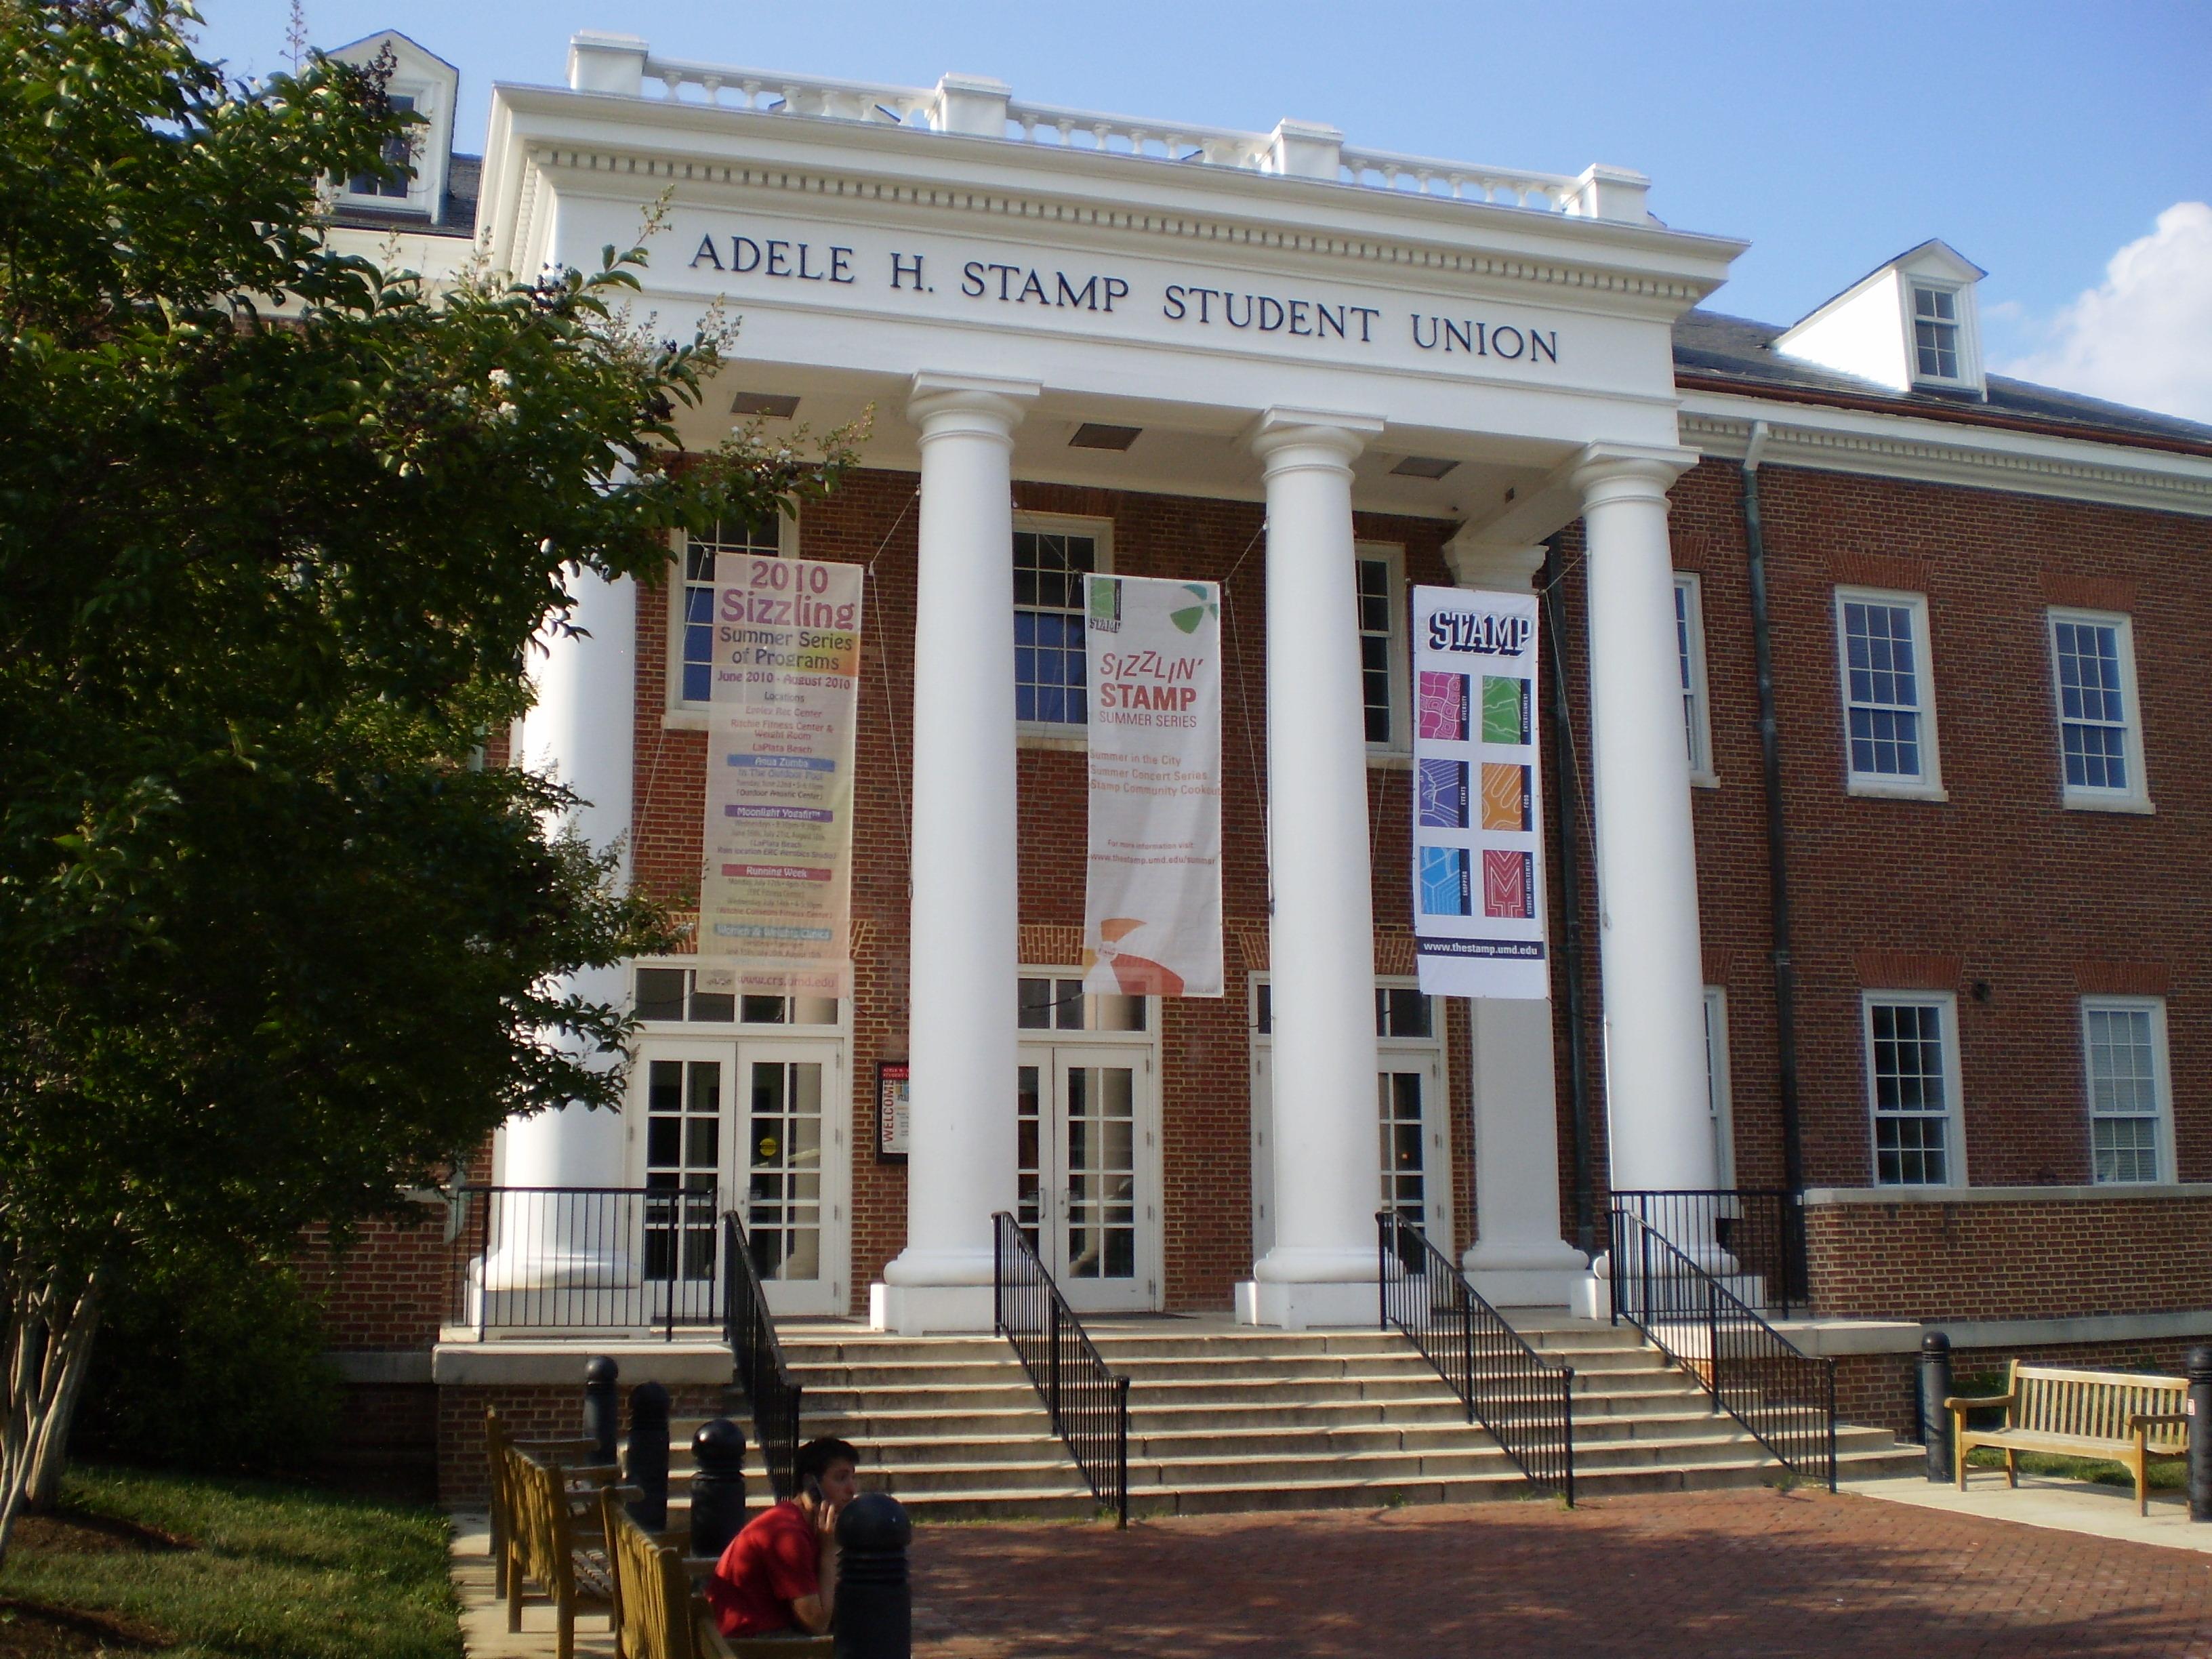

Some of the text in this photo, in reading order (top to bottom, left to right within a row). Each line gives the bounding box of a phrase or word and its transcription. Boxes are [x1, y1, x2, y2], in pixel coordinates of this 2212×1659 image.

[689, 232, 1557, 365] ADELE H. STAMP STUDENT UNION
[750, 560, 829, 594] 2010
[720, 588, 855, 630] Sizzling
[720, 626, 853, 651] Summer Series
[1429, 610, 1533, 657] STAMP
[732, 648, 840, 670] of Programs
[1100, 651, 1204, 684] SIZZLIN'
[718, 670, 743, 682] June
[746, 672, 774, 683] 2010
[783, 674, 821, 687] August
[825, 677, 851, 689] 2010
[764, 691, 805, 703] Locations
[1101, 682, 1196, 712] STAMP
[795, 708, 823, 718] Center
[1100, 711, 1197, 727] SUMMER SERIES
[731, 719, 760, 729] Ritchie
[763, 720, 793, 730] Fitness
[797, 722, 823, 733] Center
[755, 730, 811, 740] Weight Room
[787, 744, 813, 754] Beach
[1089, 749, 1181, 766] Summer in the City
[779, 758, 808, 768] Zumba
[1090, 764, 1208, 781] Summer Concert Series
[1090, 779, 1120, 792] Stamp
[1124, 783, 1177, 797] Community
[737, 807, 779, 818] Moonlight
[746, 866, 807, 878] Running Week
[1423, 942, 1538, 956] www.thestamp.umd.edu
[883, 1080, 894, 1143] WELCOME
